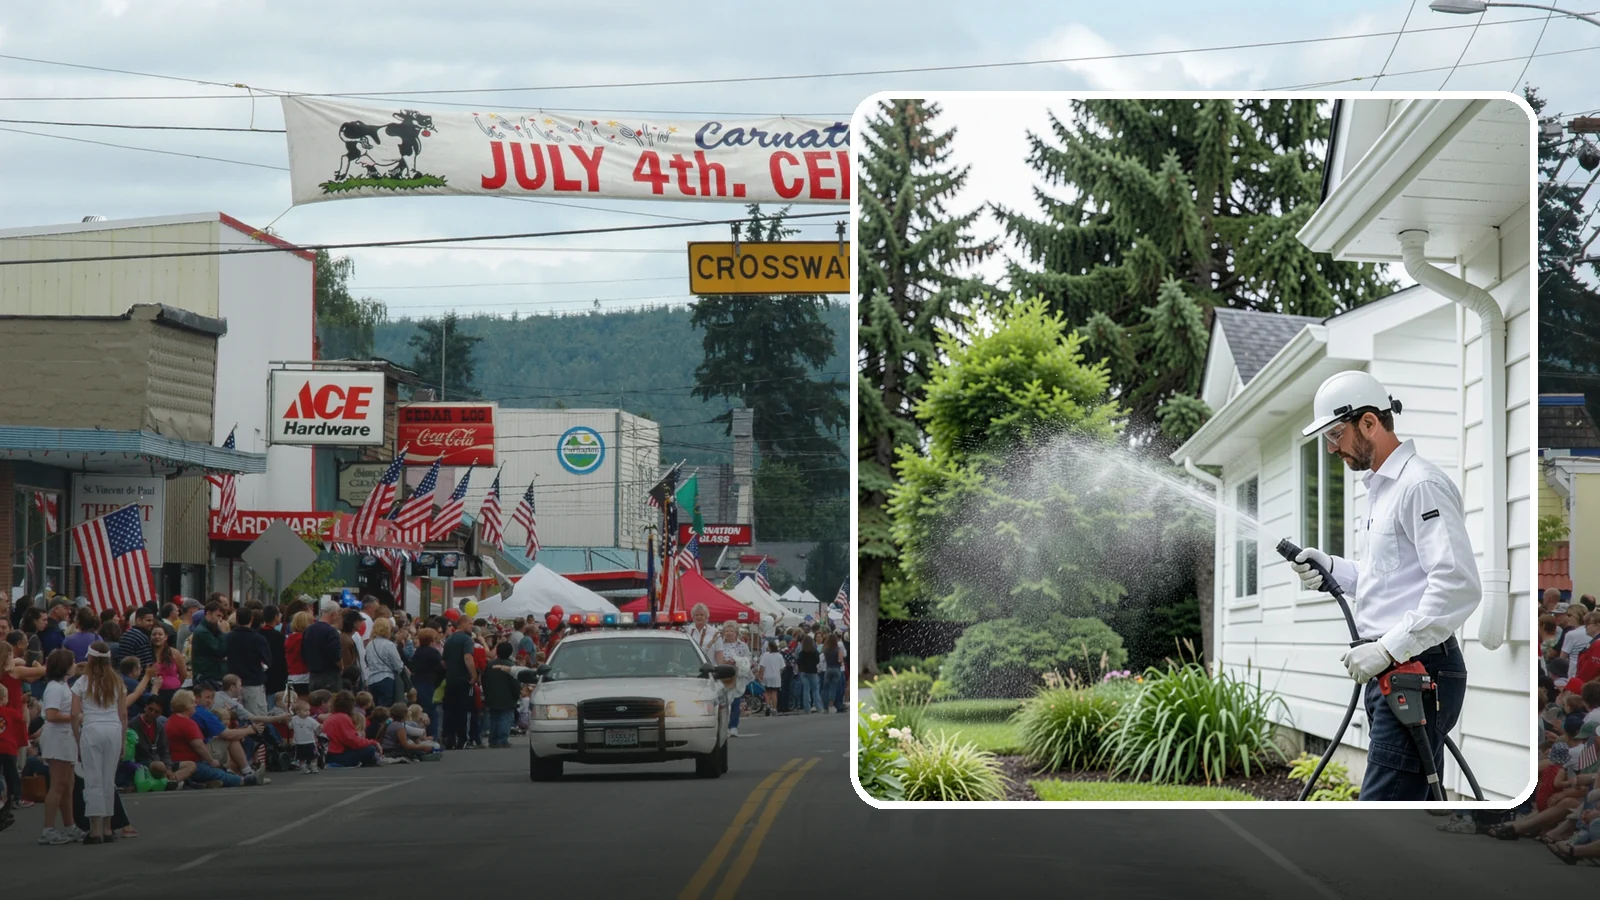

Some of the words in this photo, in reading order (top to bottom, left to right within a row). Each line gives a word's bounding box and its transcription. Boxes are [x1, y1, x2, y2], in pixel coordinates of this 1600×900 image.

[695, 121, 850, 150] Carnat
[481, 141, 604, 192] JULY
[632, 150, 746, 198] 4th.
[697, 254, 850, 280] CROSSWA
[283, 380, 373, 420] ACE
[406, 409, 452, 421] CEDAR
[283, 421, 371, 436] Hardware
[416, 428, 477, 446] Coca-Cola
[353, 467, 385, 480] Simpl
[95, 485, 124, 494] Vincent
[126, 486, 136, 494] de
[137, 486, 155, 495] Paul
[688, 526, 741, 535] CRNATION
[699, 535, 730, 543] GLASS
